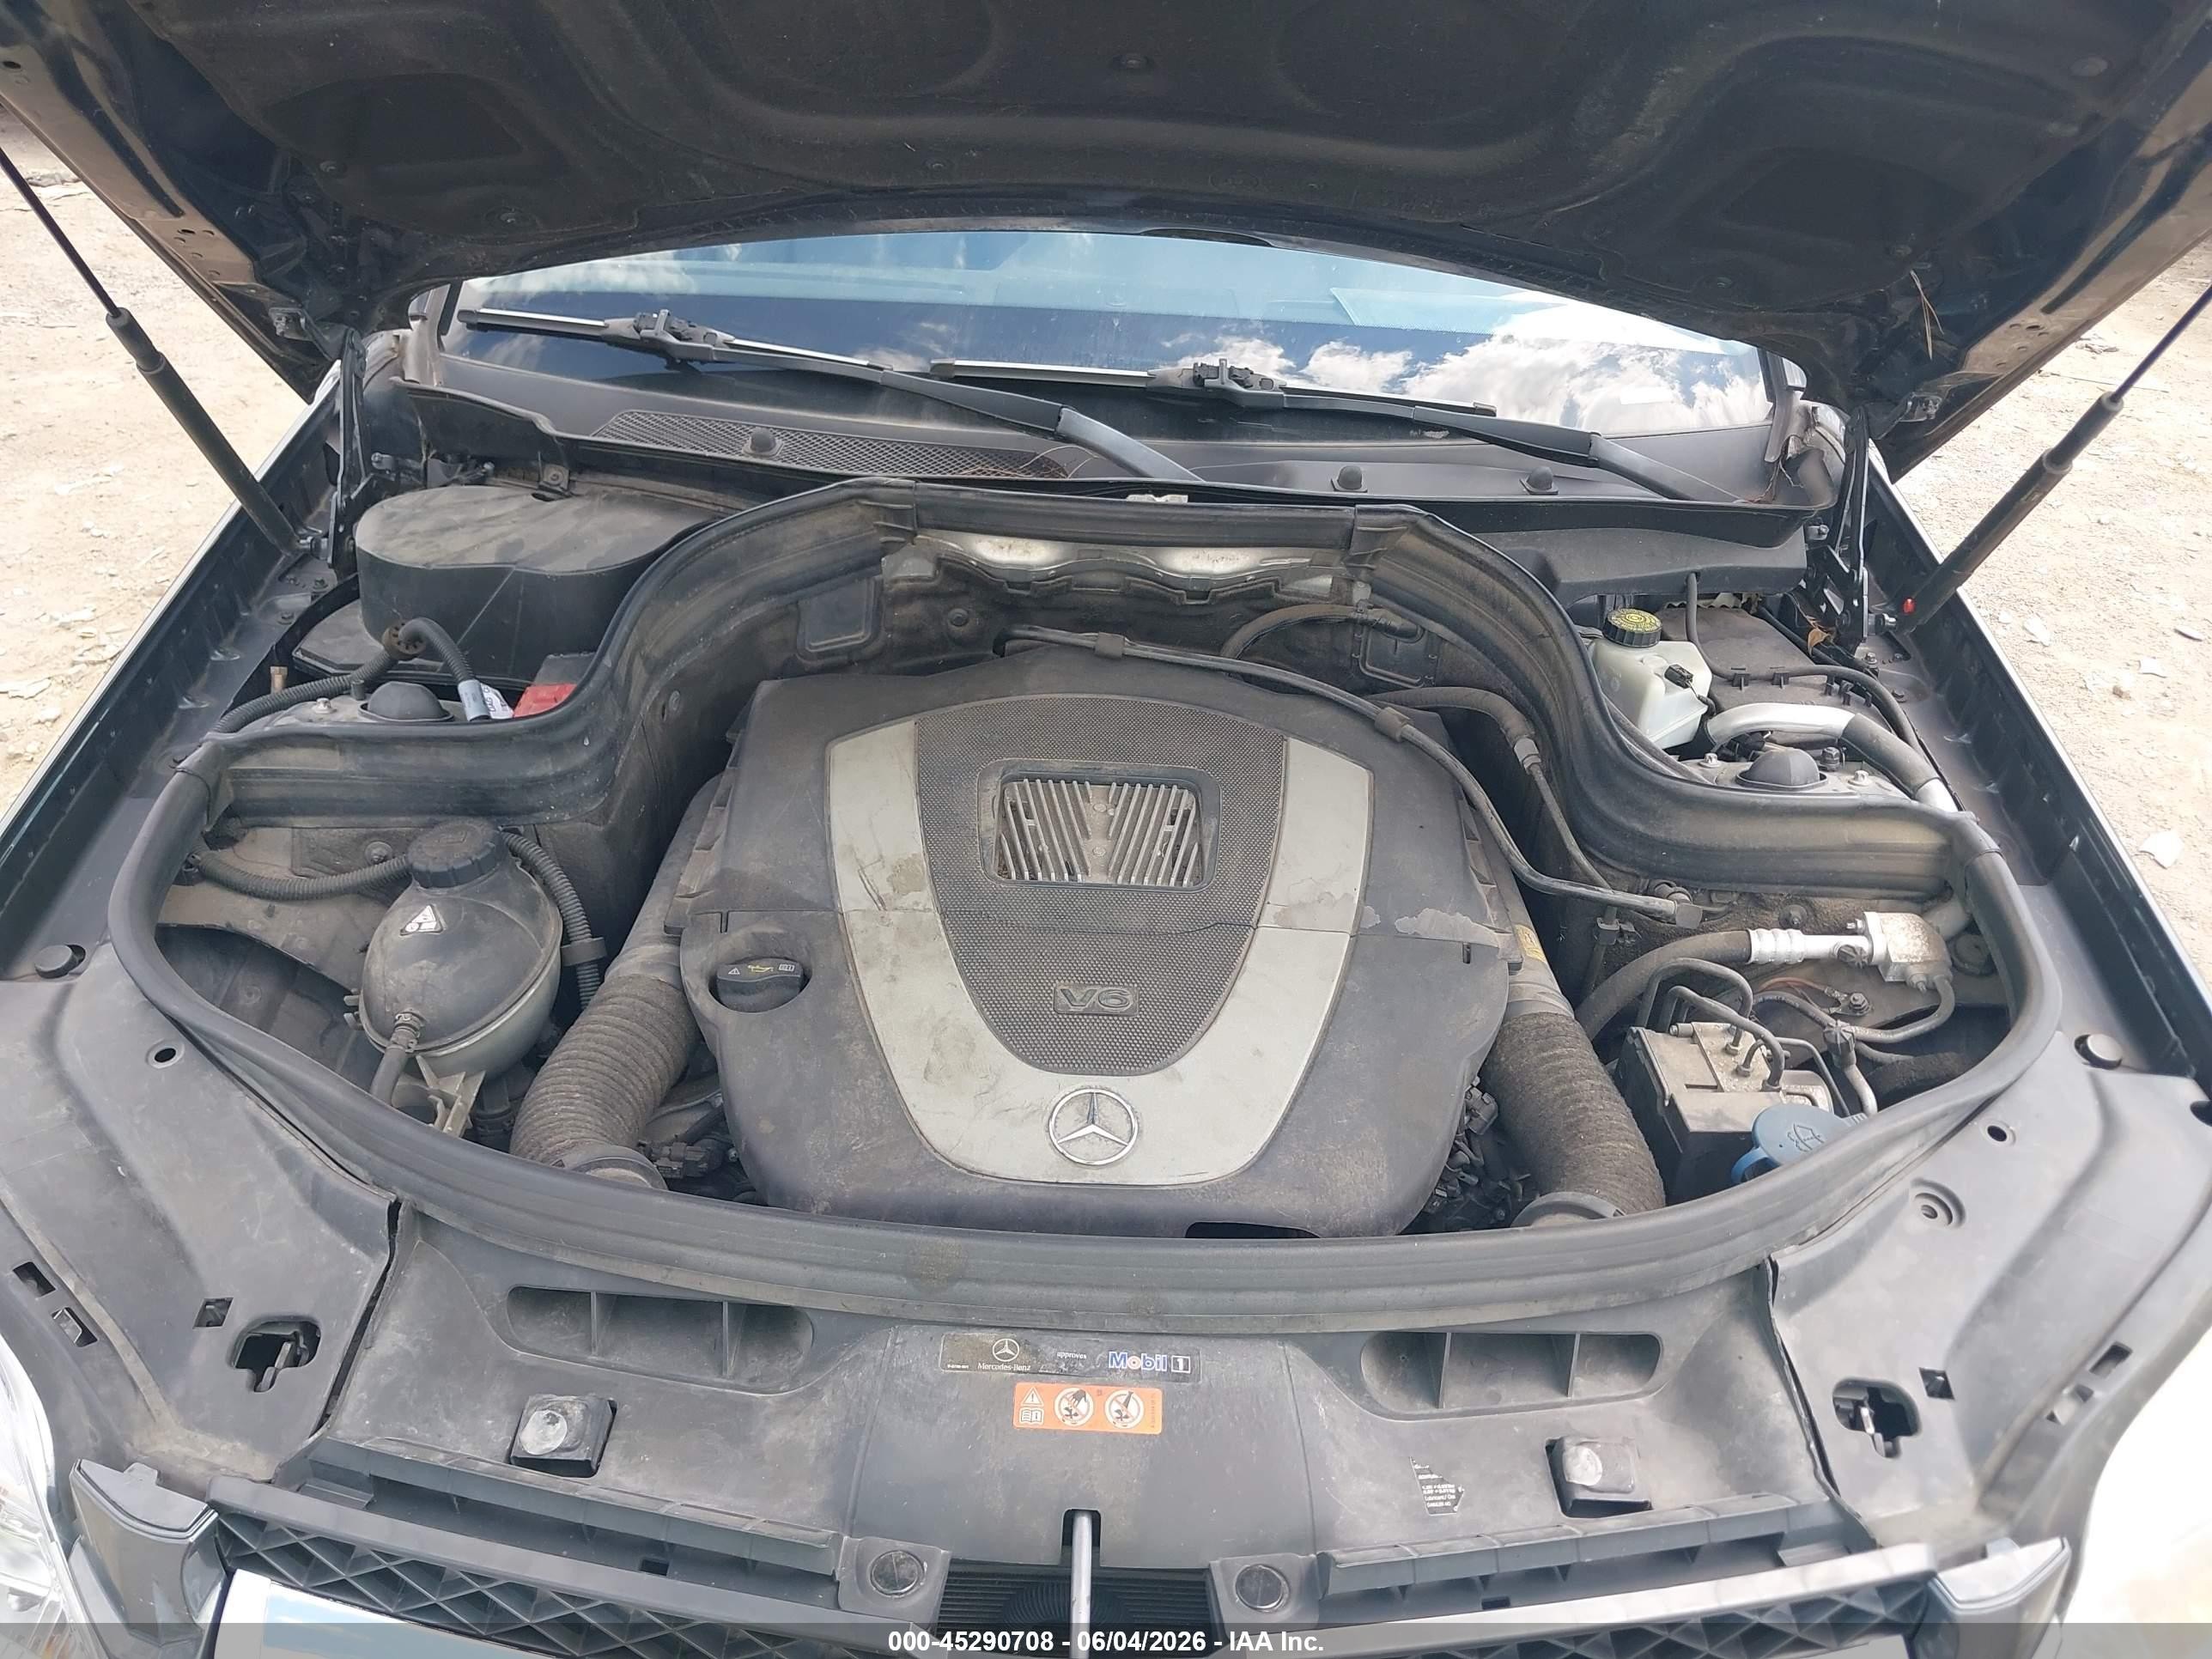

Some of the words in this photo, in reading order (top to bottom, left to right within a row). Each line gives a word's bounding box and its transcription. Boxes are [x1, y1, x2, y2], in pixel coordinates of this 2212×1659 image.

[1060, 988, 1132, 1009] V6
[1056, 1351, 1087, 1360] approves
[1108, 1351, 1168, 1372] Mobil
[977, 1362, 1031, 1371] Mercedes-Benz
